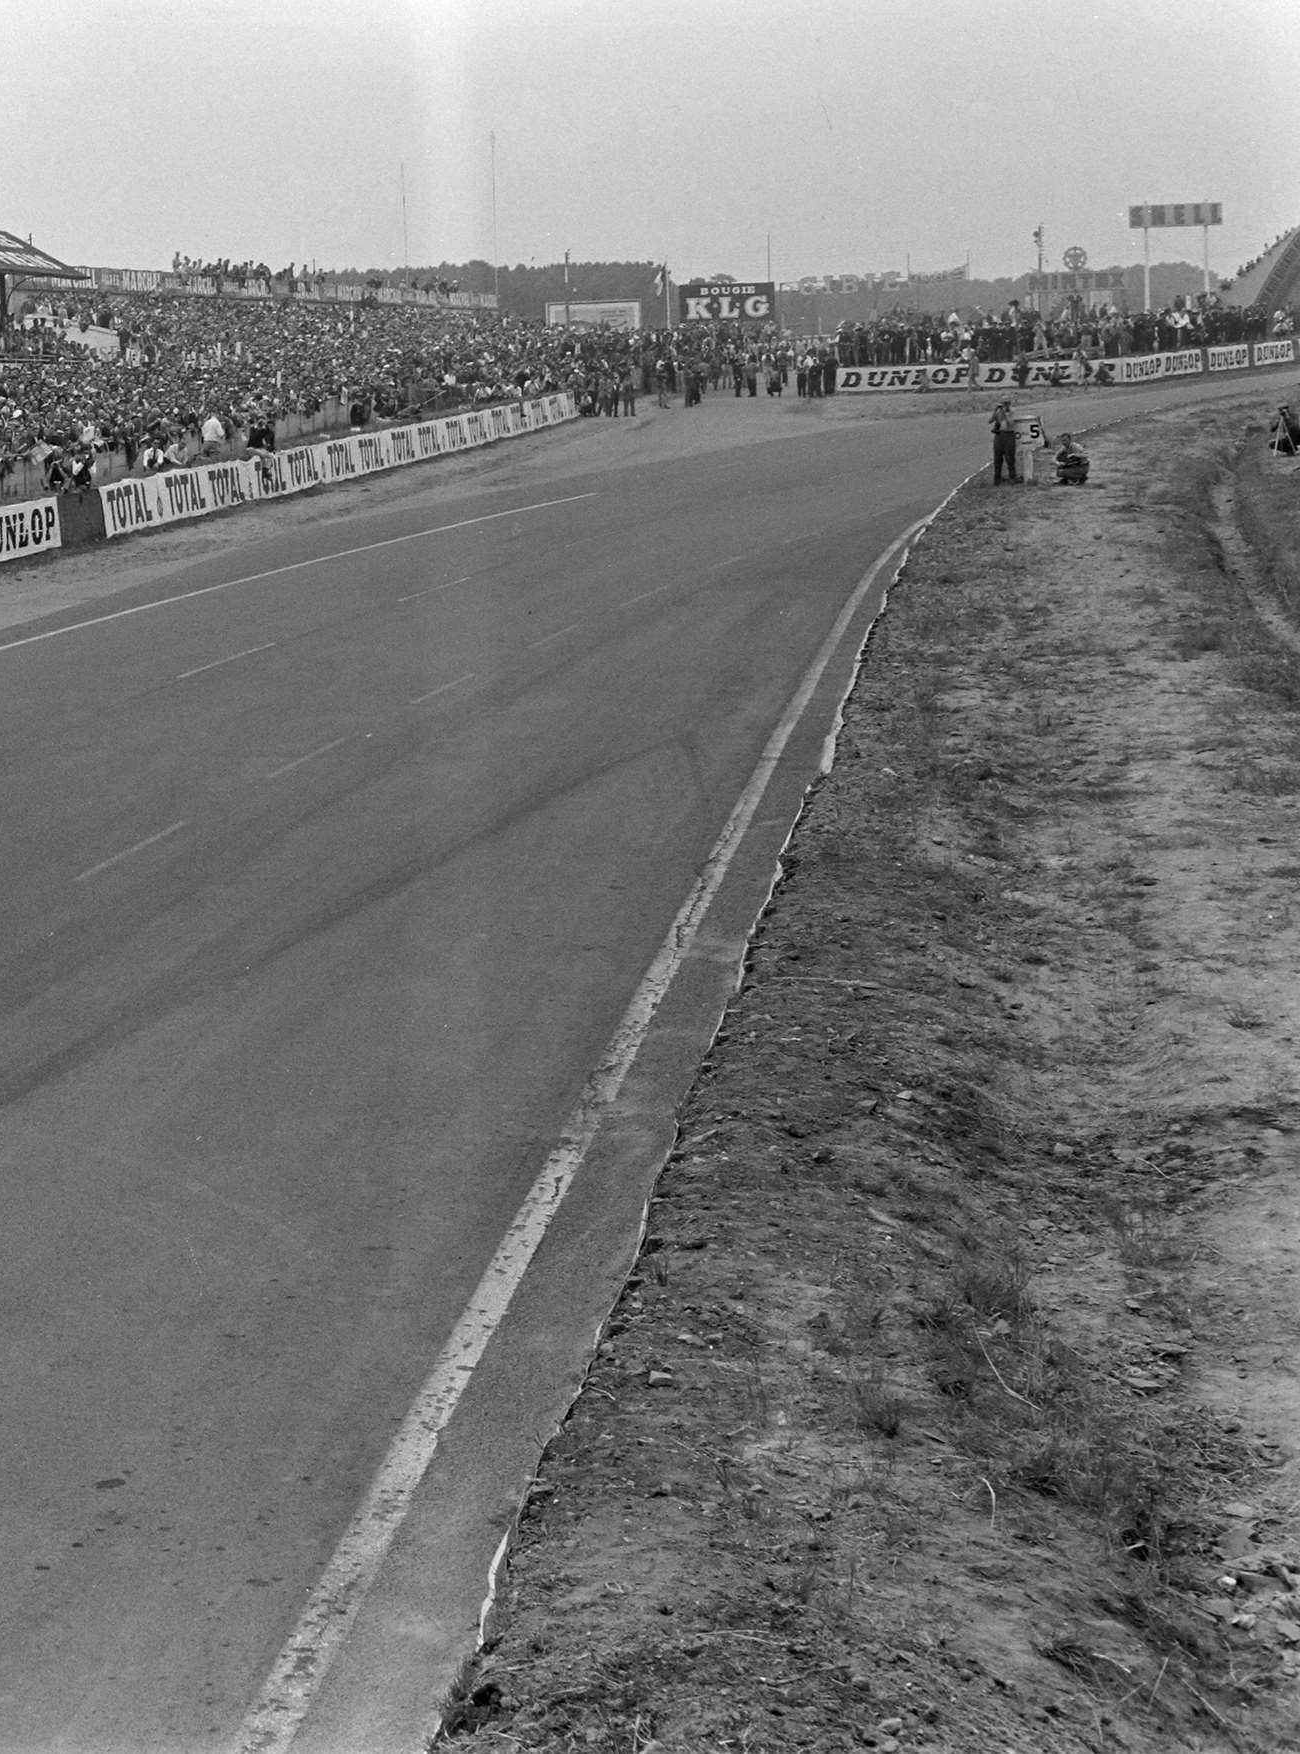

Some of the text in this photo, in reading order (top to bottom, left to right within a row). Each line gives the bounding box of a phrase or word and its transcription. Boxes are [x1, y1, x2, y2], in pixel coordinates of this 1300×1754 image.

[700, 283, 756, 295] BOUGIE
[1126, 357, 1162, 378] DUNLOP
[1165, 353, 1200, 372] DUNLOP
[1210, 349, 1248, 367] DUNLOP
[391, 429, 415, 462] TOTAL
[417, 425, 441, 457] TOTAL
[1030, 424, 1040, 438] 5
[287, 447, 319, 487] TOTAL
[327, 441, 356, 478] TOTAL
[358, 437, 385, 471] TOTAL
[165, 471, 206, 516] TOTAL
[208, 466, 246, 507] TOTAL
[106, 482, 153, 531] TOTAL
